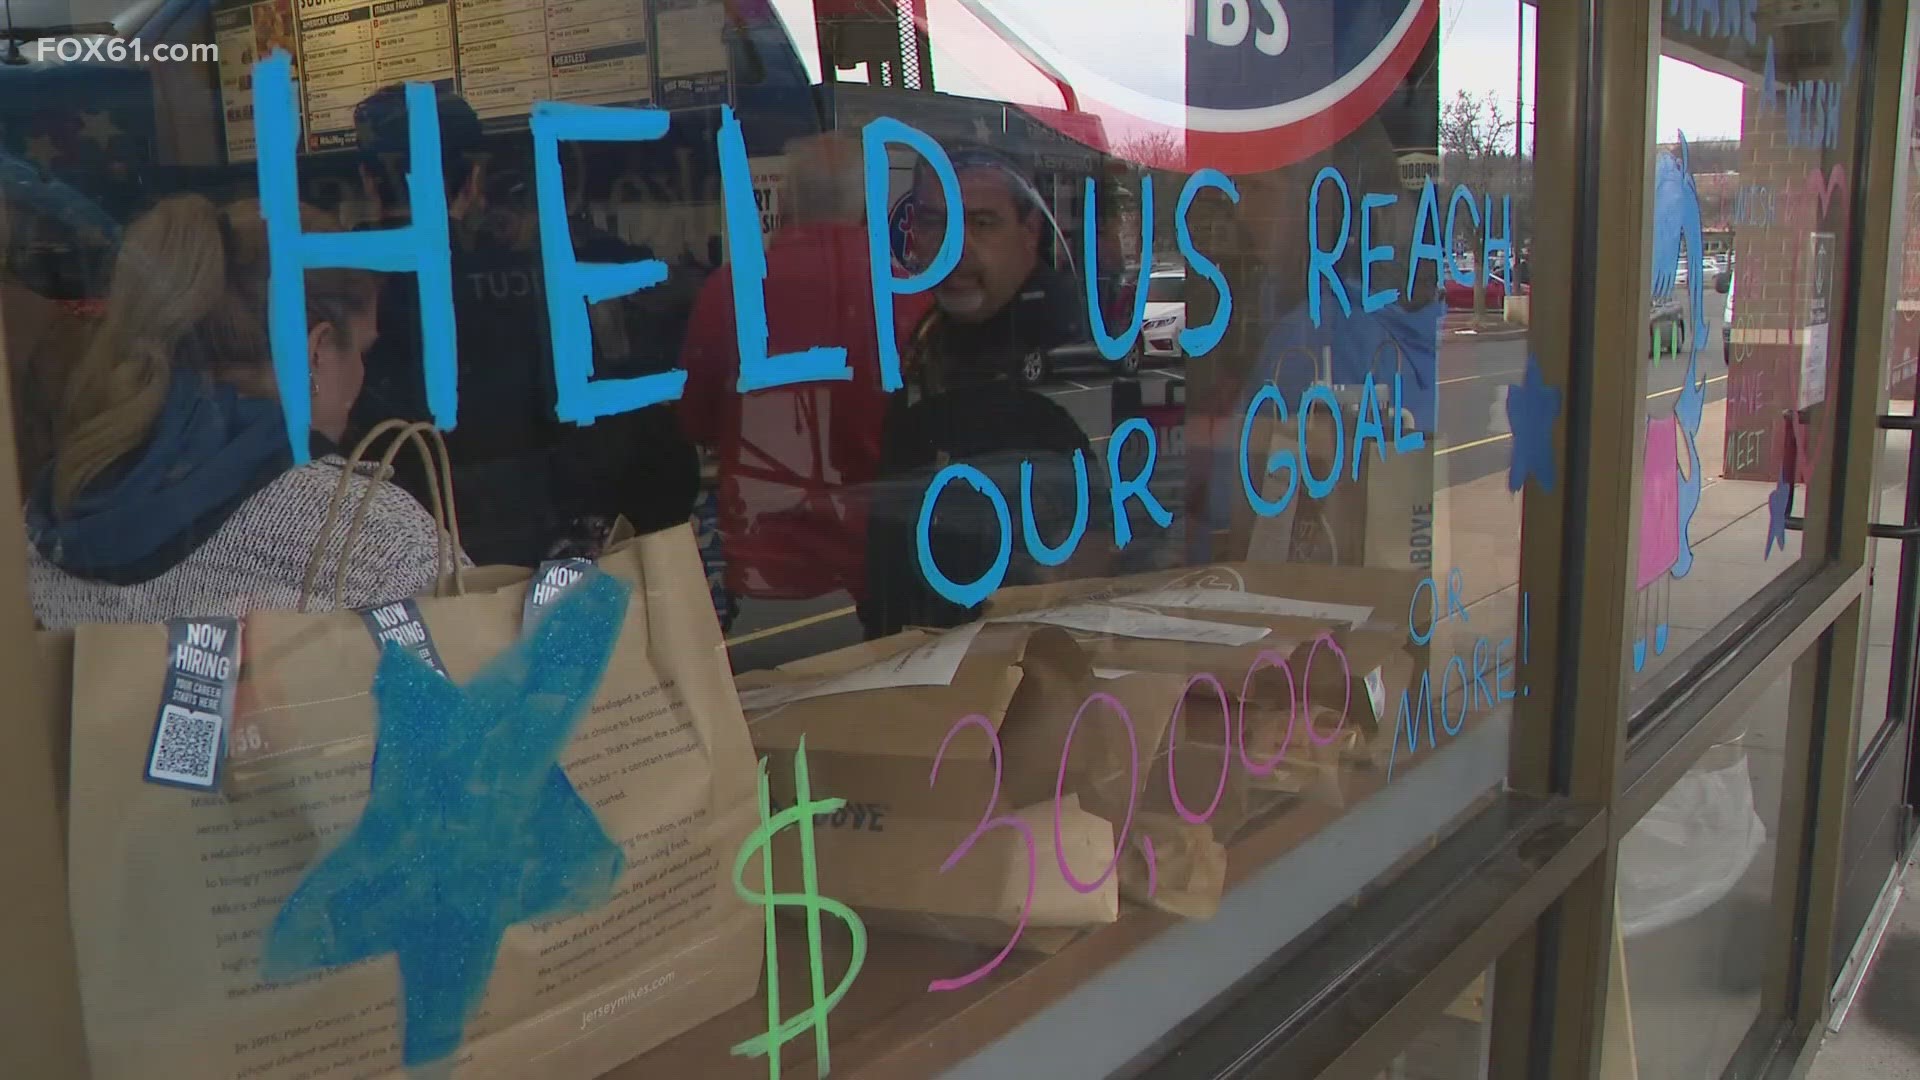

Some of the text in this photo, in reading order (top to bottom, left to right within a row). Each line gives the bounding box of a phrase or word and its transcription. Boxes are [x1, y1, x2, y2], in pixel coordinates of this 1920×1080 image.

[554, 52, 587, 66] MEATLESS
[1785, 78, 1842, 151] WISH
[1732, 184, 1778, 230] WISH
[251, 51, 1513, 466] HELP US REACH
[1724, 429, 1766, 475] MEET
[917, 371, 1427, 609] OUR GOAL
[371, 601, 410, 629] NOW
[1408, 567, 1470, 646] OR
[187, 623, 228, 653] NOW
[176, 644, 232, 681] HIRING
[172, 689, 220, 711] STARTS HERE
[193, 682, 222, 698] CAREER
[1387, 591, 1532, 785] MORE!
[580, 970, 676, 1030] jerseymikes.com
